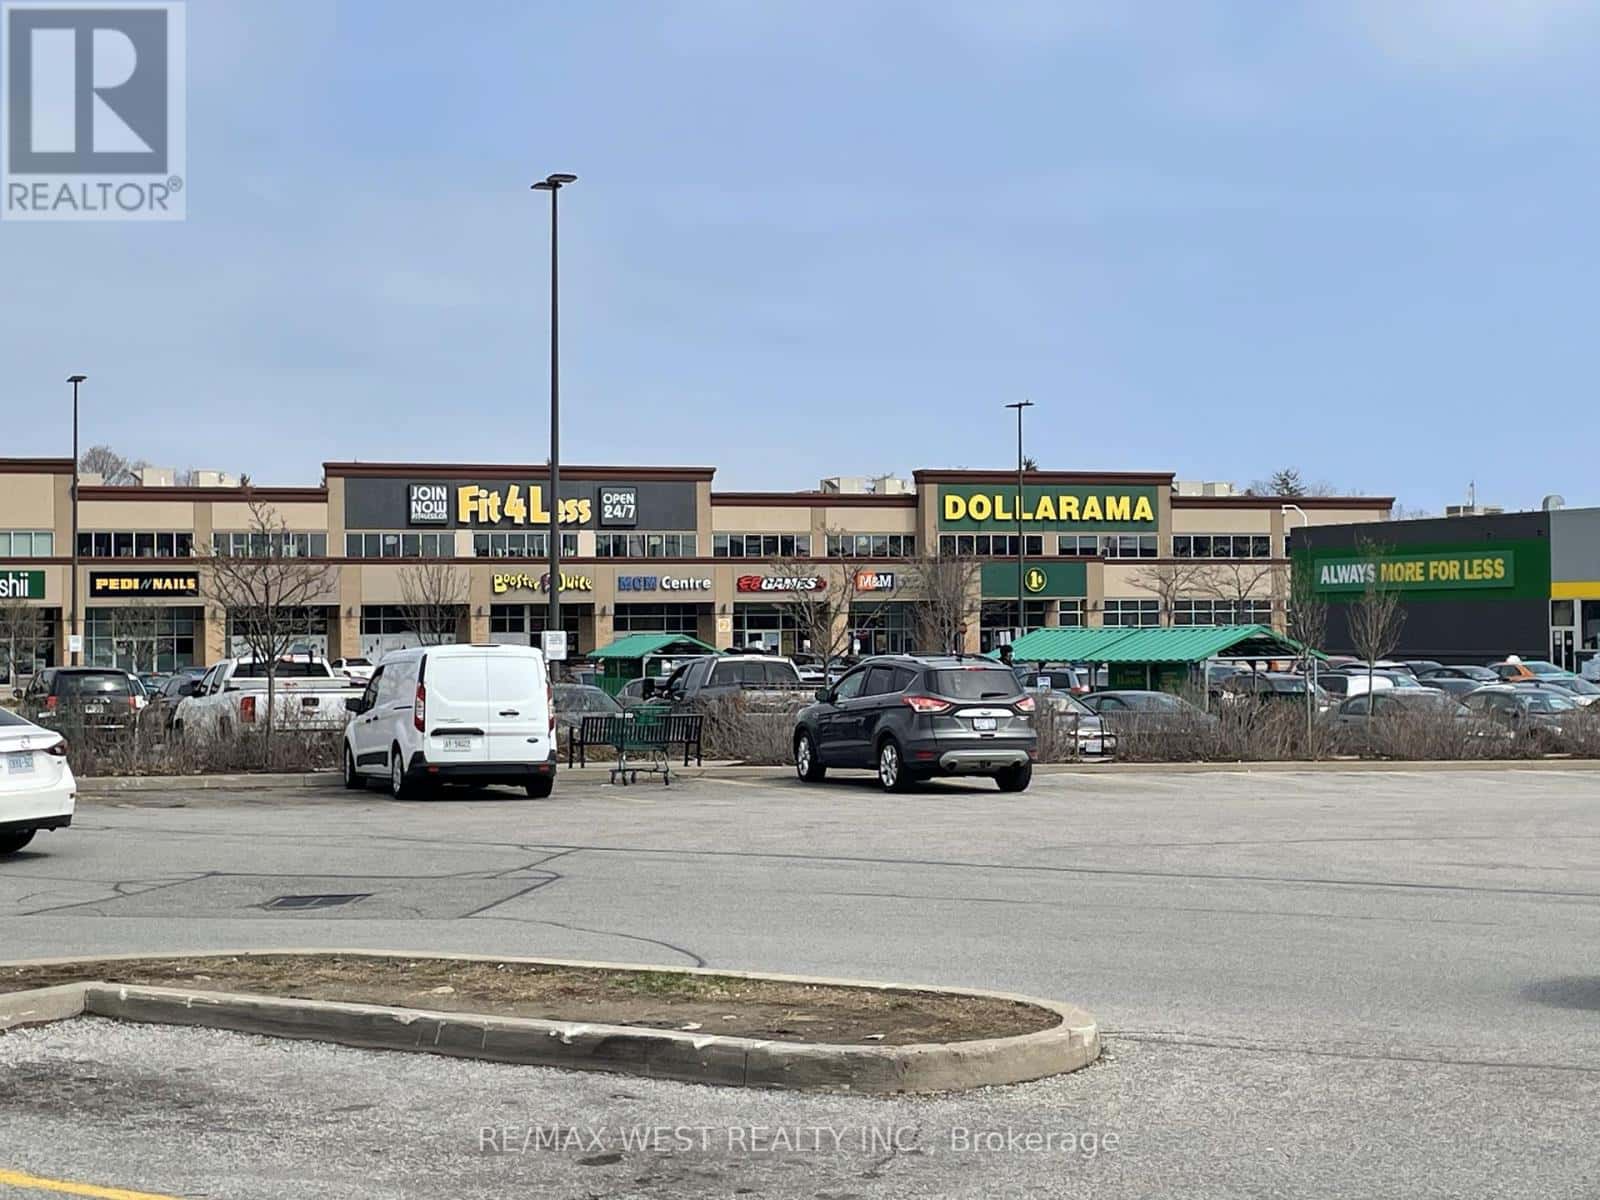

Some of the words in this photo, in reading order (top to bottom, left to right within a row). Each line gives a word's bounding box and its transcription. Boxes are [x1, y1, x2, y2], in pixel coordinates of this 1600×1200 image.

[411, 486, 448, 501] JOIN
[603, 493, 635, 505] OPEN
[411, 501, 448, 515] NOW
[604, 504, 636, 519] 24/7
[944, 494, 1154, 521] DOLLARAMA
[1320, 564, 1377, 585] ALWAYS
[1380, 561, 1425, 582] MORE
[1428, 560, 1460, 581] FOR
[1463, 557, 1505, 580] LESS
[0, 572, 29, 597] shii
[95, 578, 140, 591] PEDI
[152, 578, 196, 591] NAILS
[493, 573, 541, 593] Booster
[557, 571, 593, 592] Juice
[660, 575, 712, 590] Centre
[760, 577, 818, 591] GAMES
[859, 573, 893, 589] M&M
